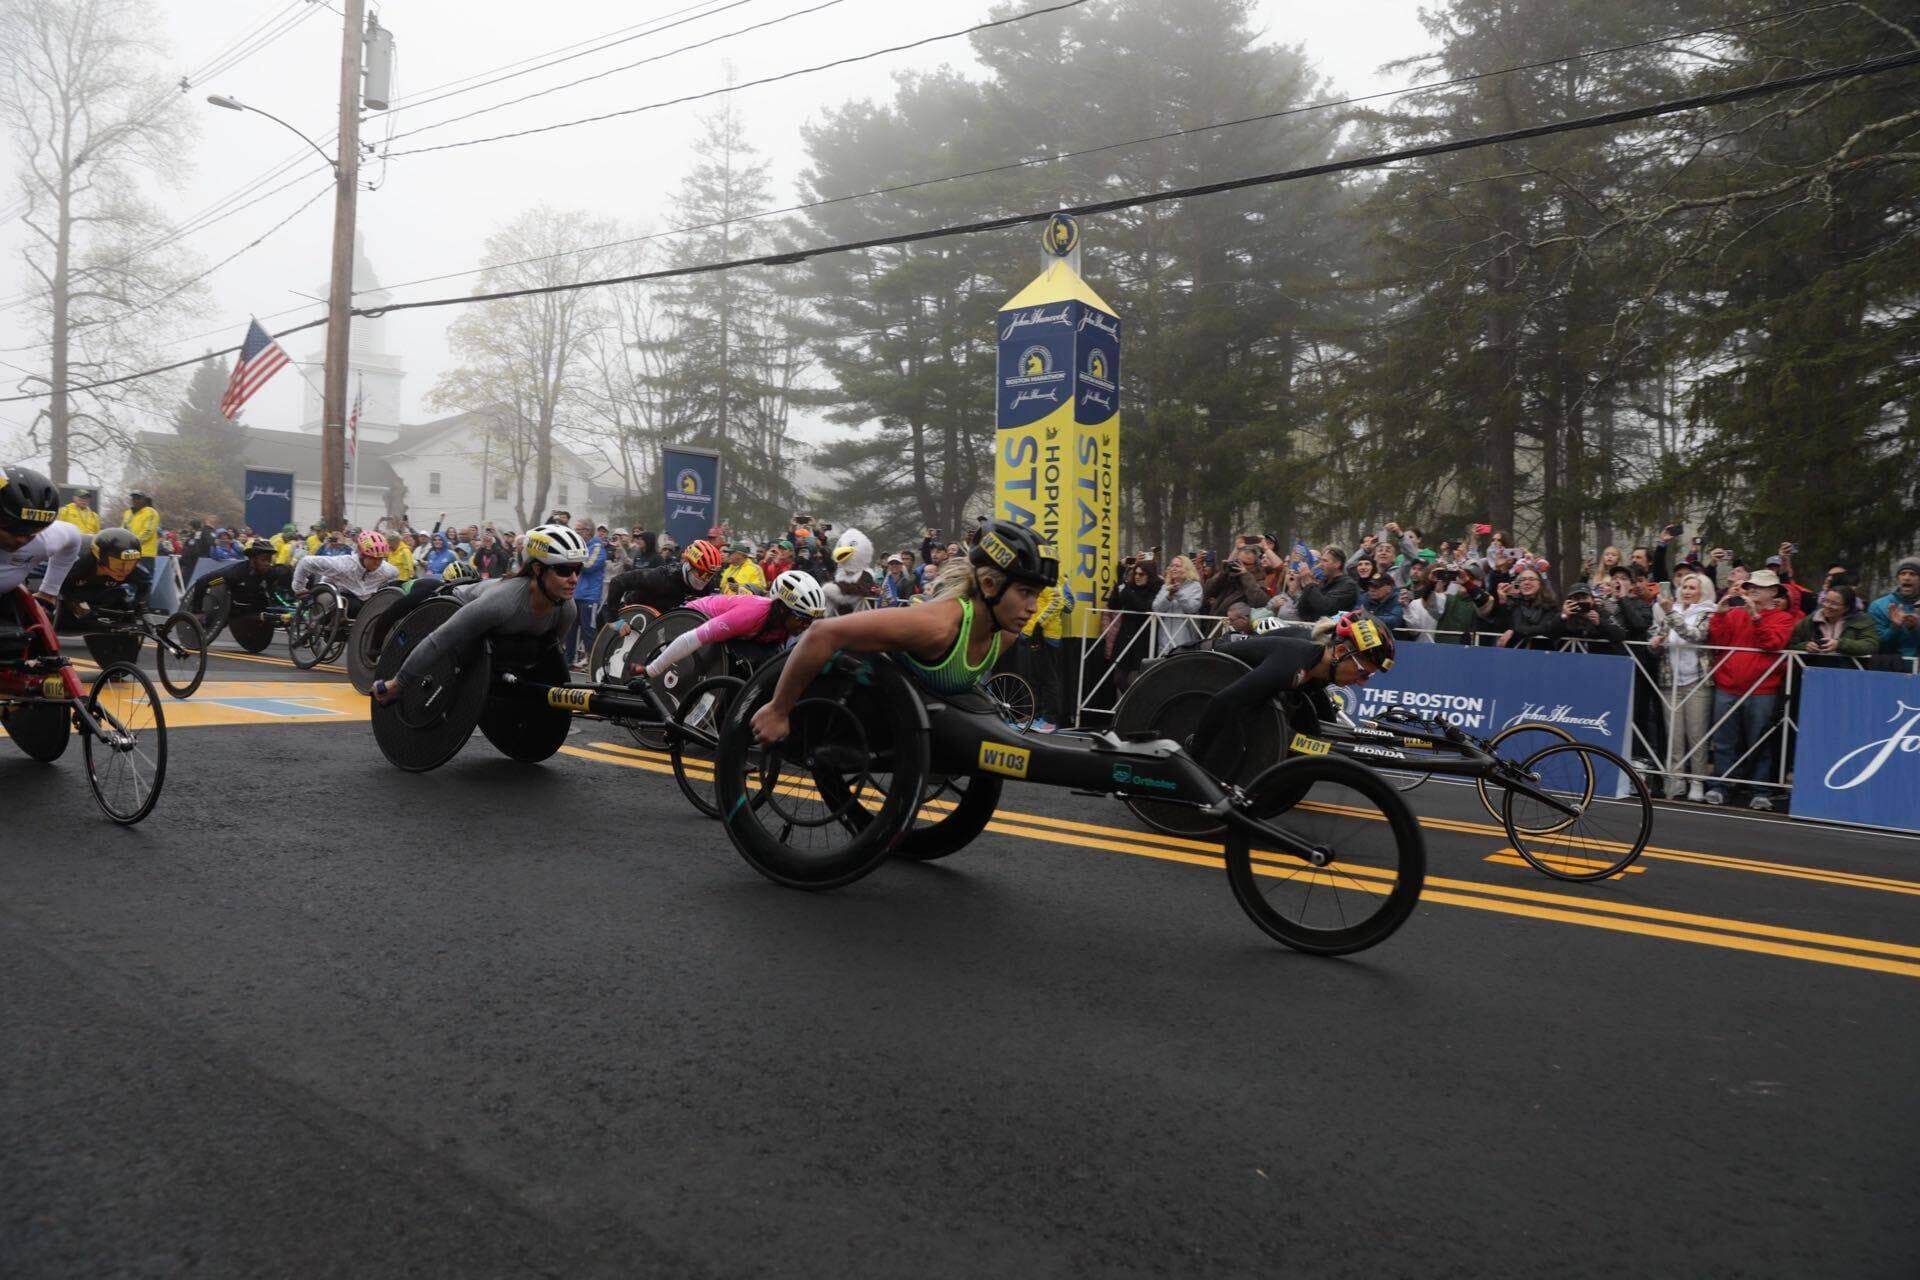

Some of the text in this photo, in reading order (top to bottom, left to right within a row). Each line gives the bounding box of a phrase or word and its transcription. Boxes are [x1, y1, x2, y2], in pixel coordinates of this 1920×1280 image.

[1004, 435, 1038, 530] STA
[1044, 445, 1060, 547] HOPKIN
[1076, 433, 1098, 614] START
[1101, 452, 1112, 602] HOPKINTON
[982, 534, 1014, 567] W103
[1357, 620, 1376, 648] W101
[1362, 688, 1483, 712] THE BOSTON
[1354, 727, 1395, 738] HONDA
[1502, 702, 1612, 736] John Hancock
[984, 747, 1026, 772] W103
[1295, 737, 1326, 754] W101
[1353, 744, 1406, 760] HONDA
